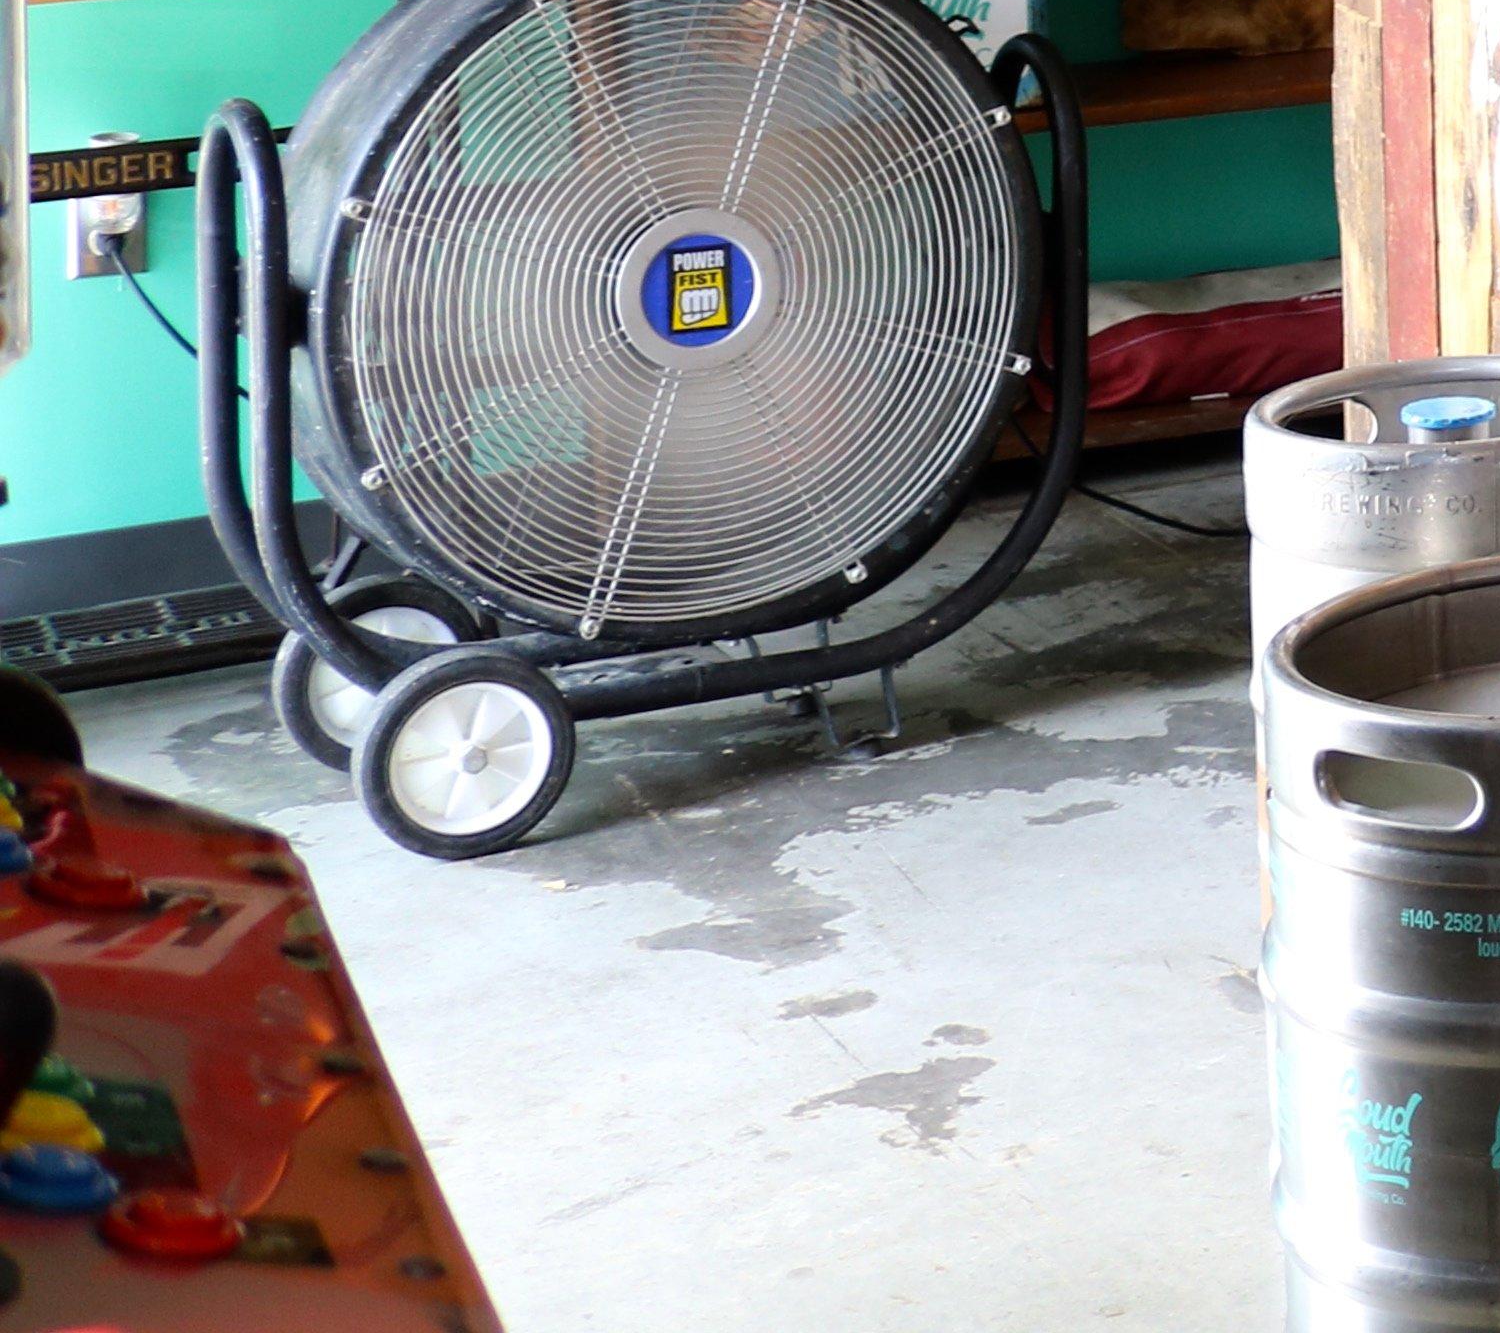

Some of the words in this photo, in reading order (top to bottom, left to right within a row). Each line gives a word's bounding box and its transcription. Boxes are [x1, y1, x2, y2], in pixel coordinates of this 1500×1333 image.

[31, 149, 174, 193] SINGER
[673, 249, 725, 272] POWER
[680, 272, 719, 287] FIST
[1401, 908, 1440, 930] #140-
[1443, 912, 1483, 933] 2582
